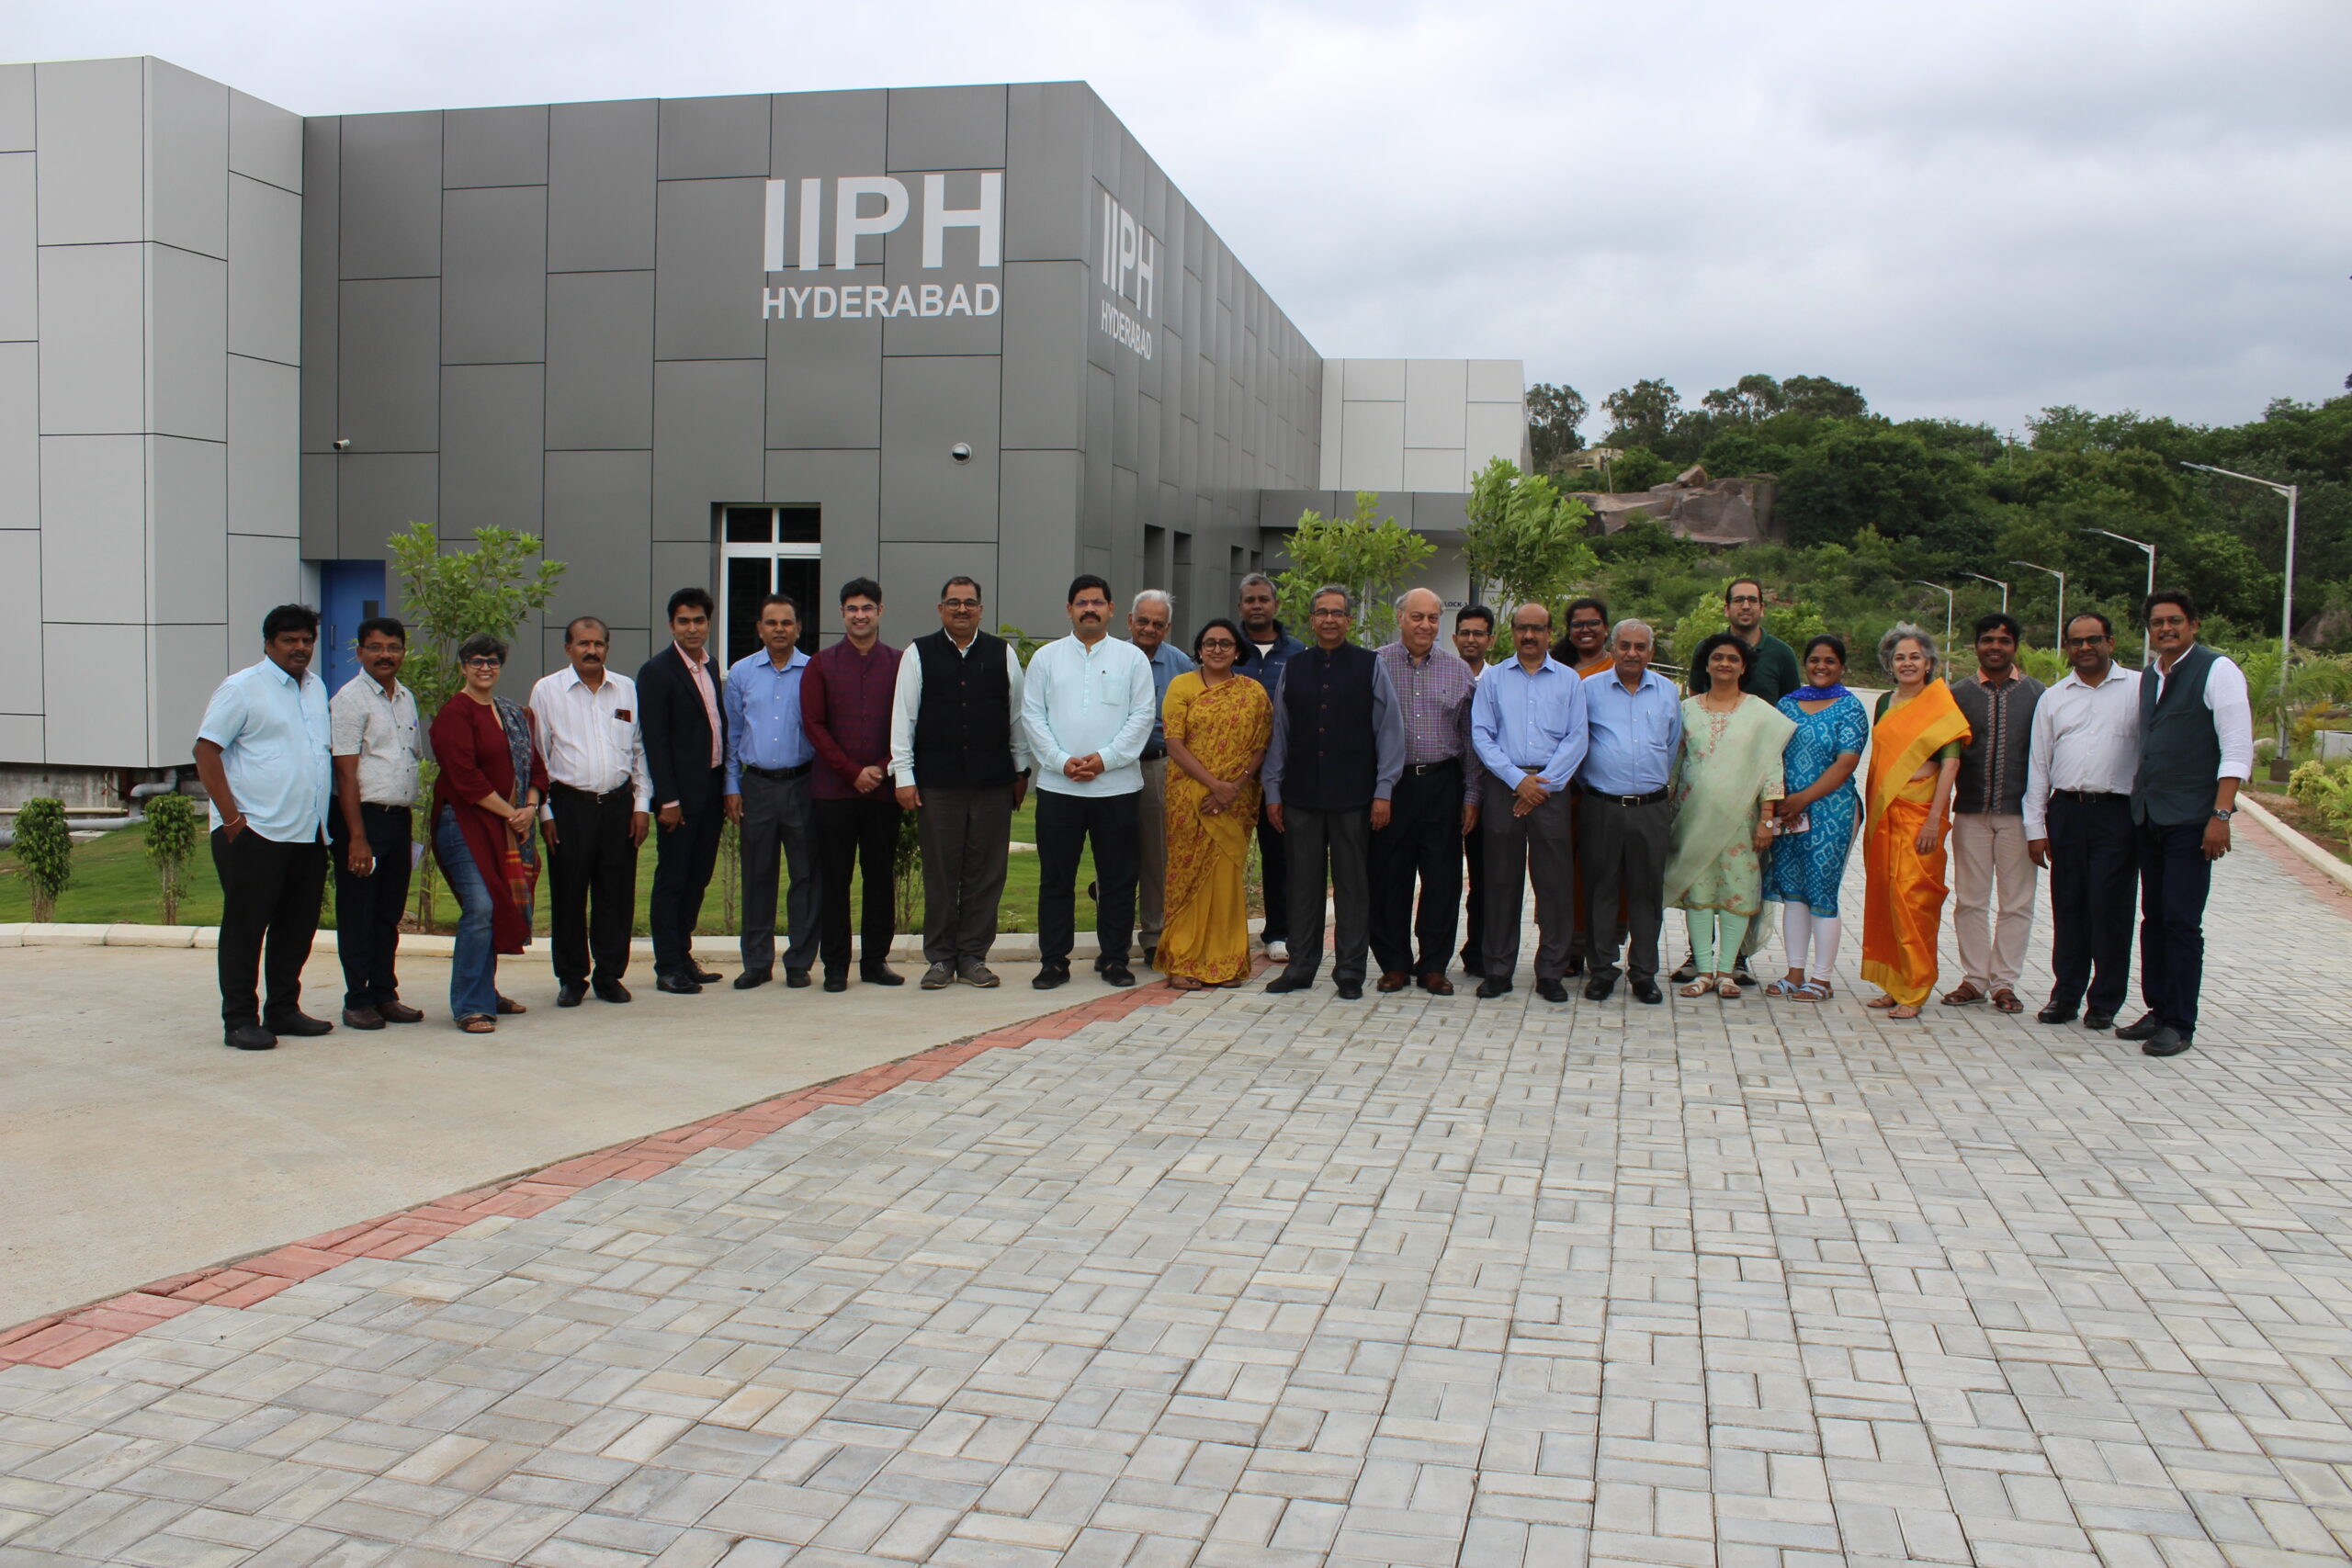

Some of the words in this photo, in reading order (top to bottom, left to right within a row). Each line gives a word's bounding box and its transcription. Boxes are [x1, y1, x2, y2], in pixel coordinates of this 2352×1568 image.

[764, 173, 1001, 272] IIPH
[1102, 192, 1154, 319] IIPH
[763, 284, 1001, 319] HYDERABAD
[1102, 299, 1152, 360] HYDERABAD
